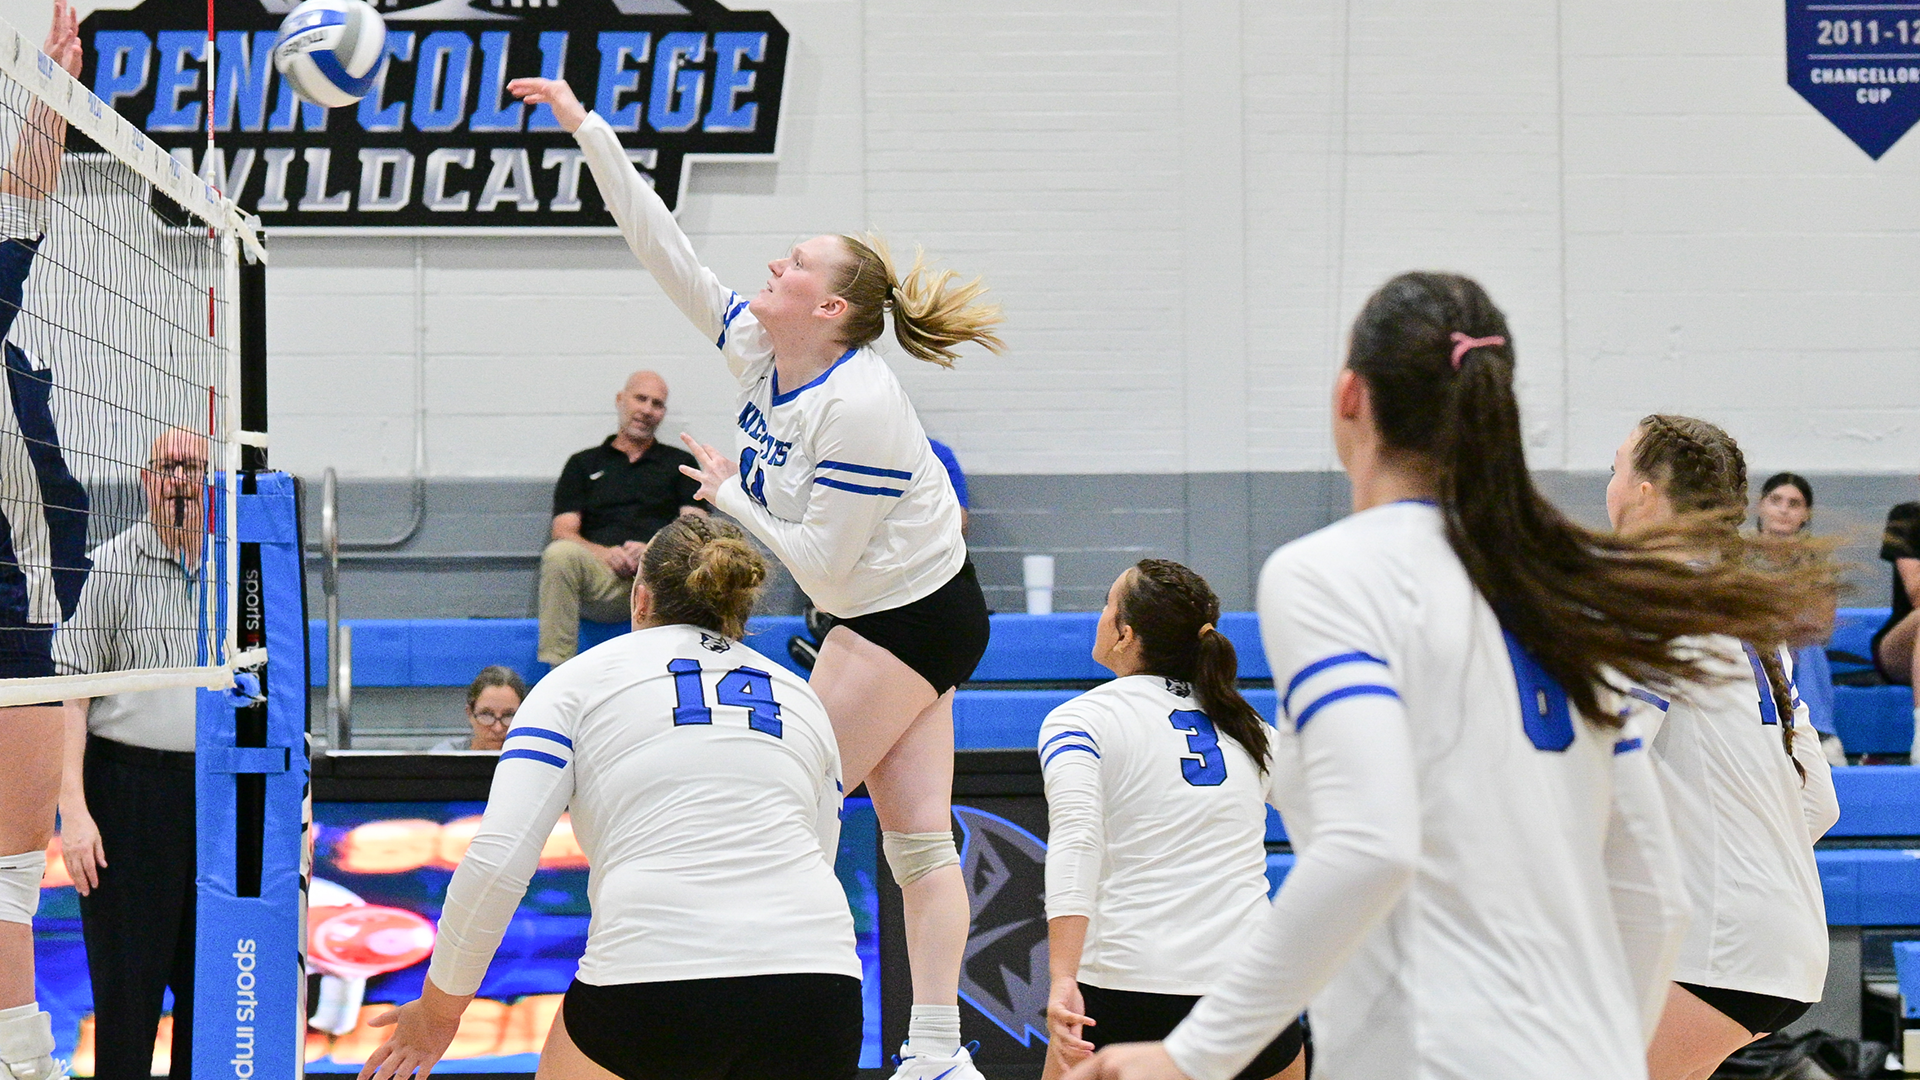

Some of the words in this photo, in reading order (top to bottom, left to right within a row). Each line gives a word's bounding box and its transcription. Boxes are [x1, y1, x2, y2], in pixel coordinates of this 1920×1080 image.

[1817, 19, 1920, 45] 2011-12
[1856, 87, 1892, 104] CUP
[244, 568, 262, 630] sports
[666, 657, 783, 741] 14
[1168, 708, 1228, 787] 3
[232, 938, 258, 1022] sports
[229, 1026, 255, 1080] imp
